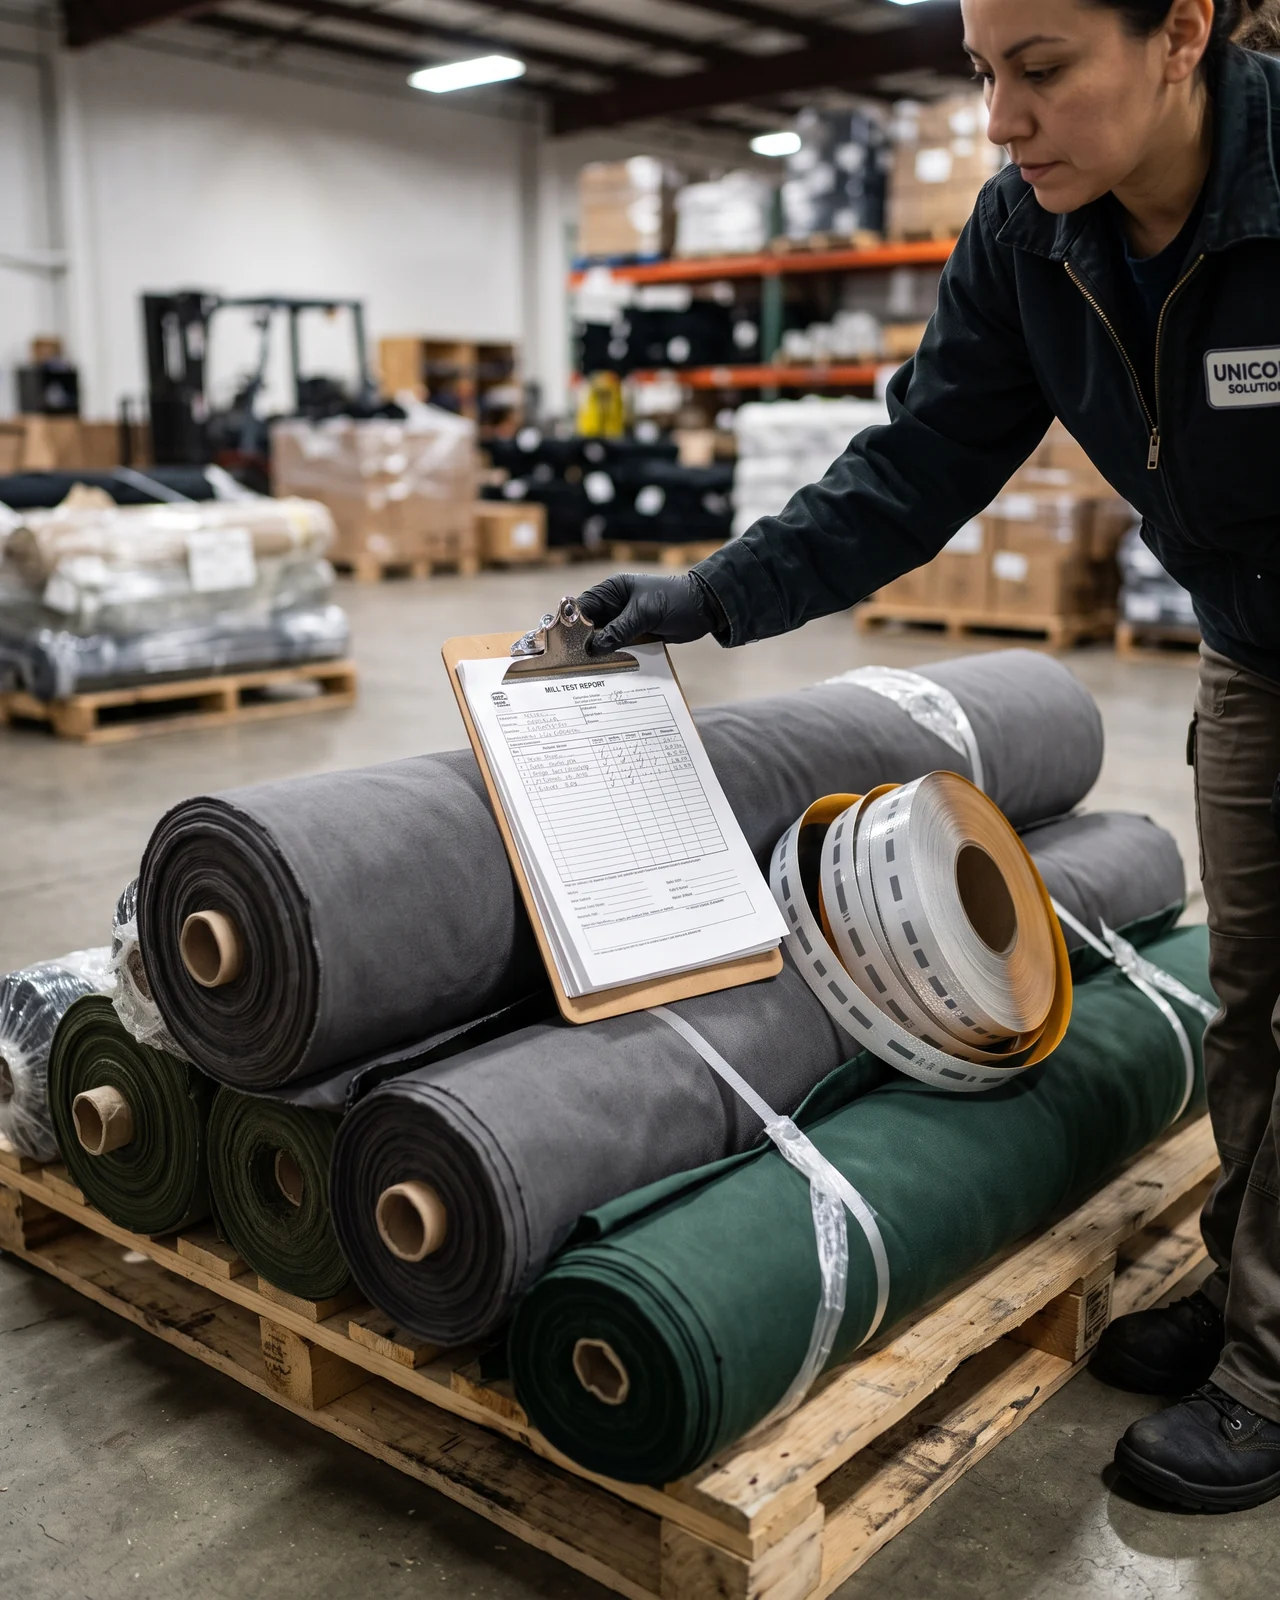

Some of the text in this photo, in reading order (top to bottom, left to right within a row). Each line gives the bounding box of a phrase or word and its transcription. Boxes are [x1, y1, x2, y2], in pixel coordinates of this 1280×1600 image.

[1213, 361, 1280, 382] UNICO
[561, 683, 578, 692] TEST
[579, 680, 606, 690] REPORT
